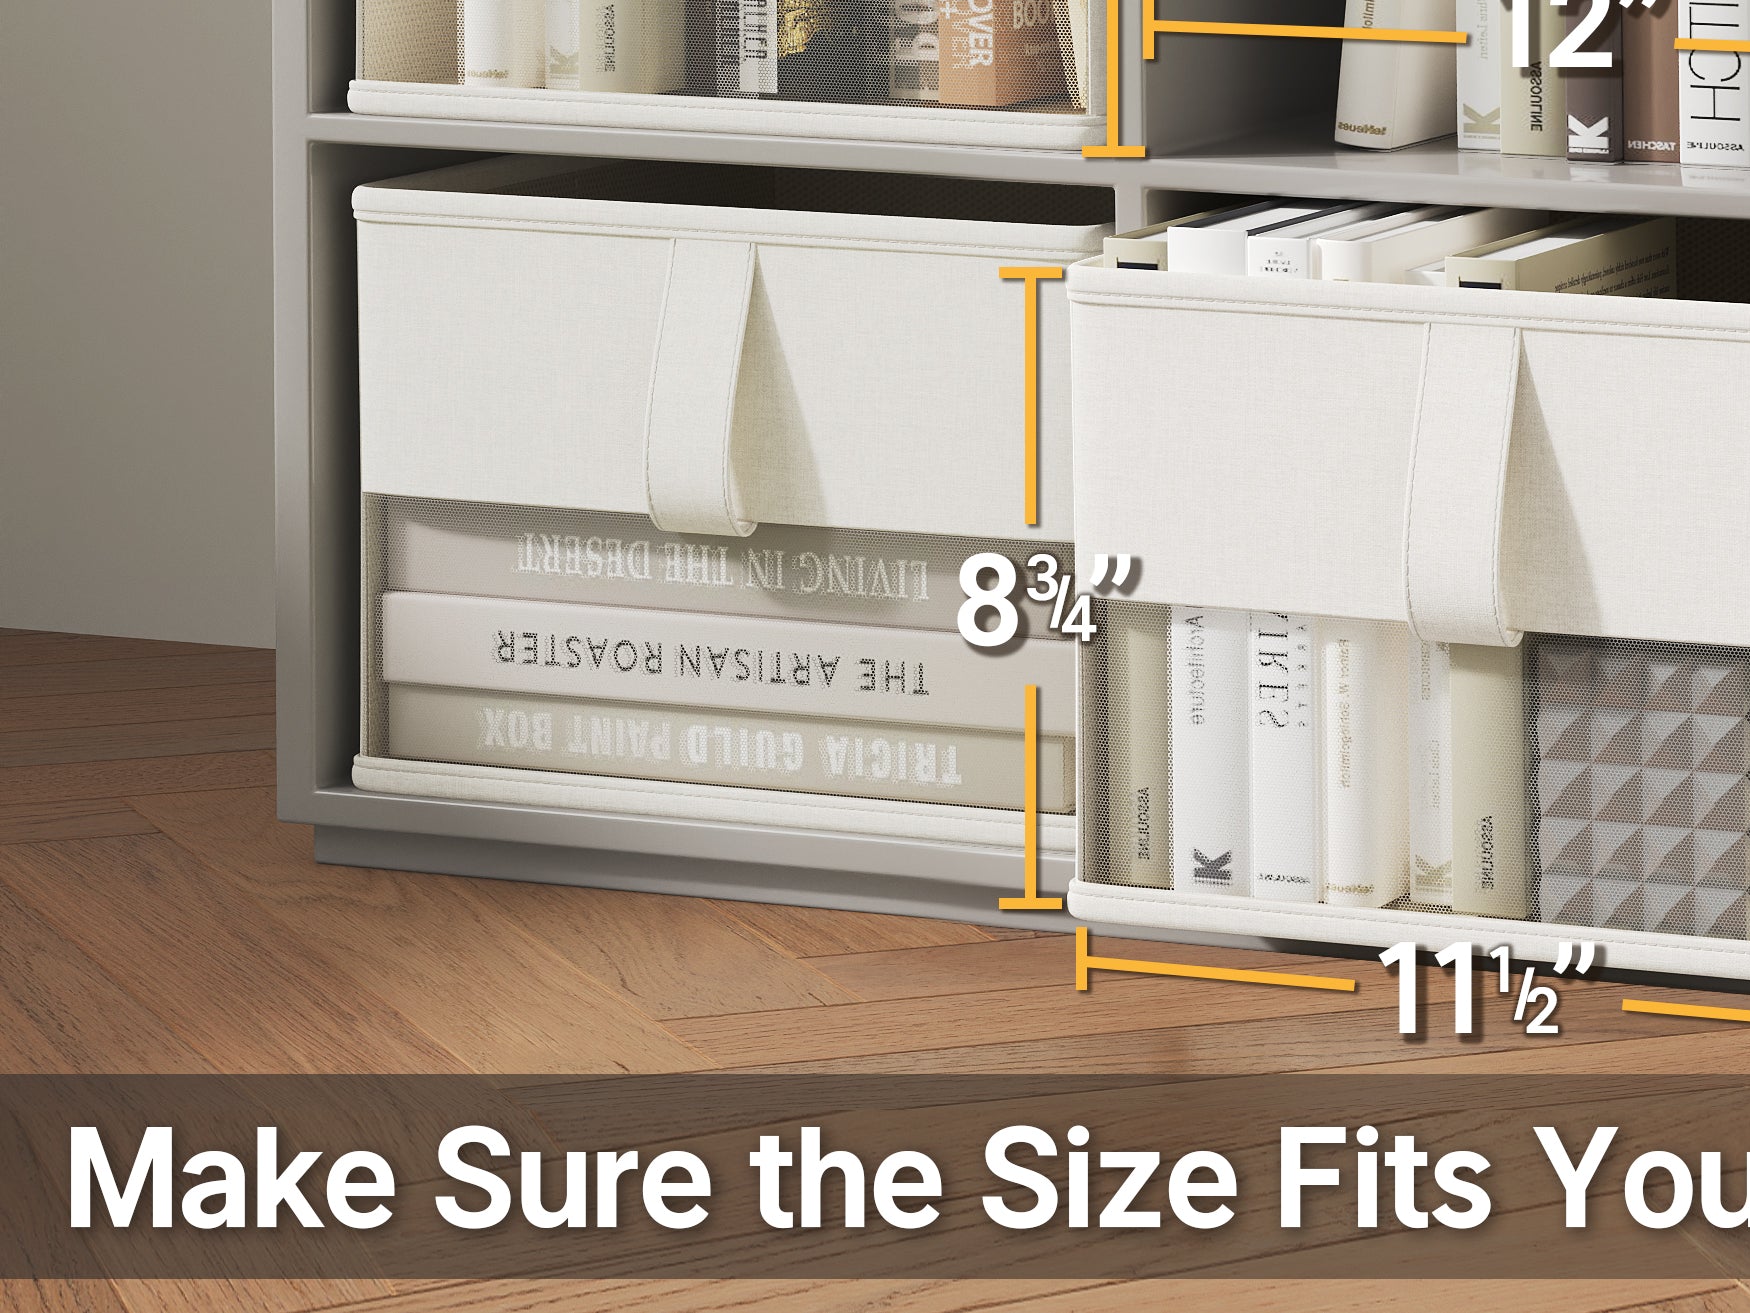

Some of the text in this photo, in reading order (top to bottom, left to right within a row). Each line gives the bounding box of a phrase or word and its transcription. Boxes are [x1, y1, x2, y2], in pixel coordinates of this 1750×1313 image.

[511, 532, 930, 602] LIVING IN THE DESERT
[496, 630, 929, 696] THE ARTISAN ROASTER
[477, 706, 962, 787] TRICIA GUILD PAINT BOX
